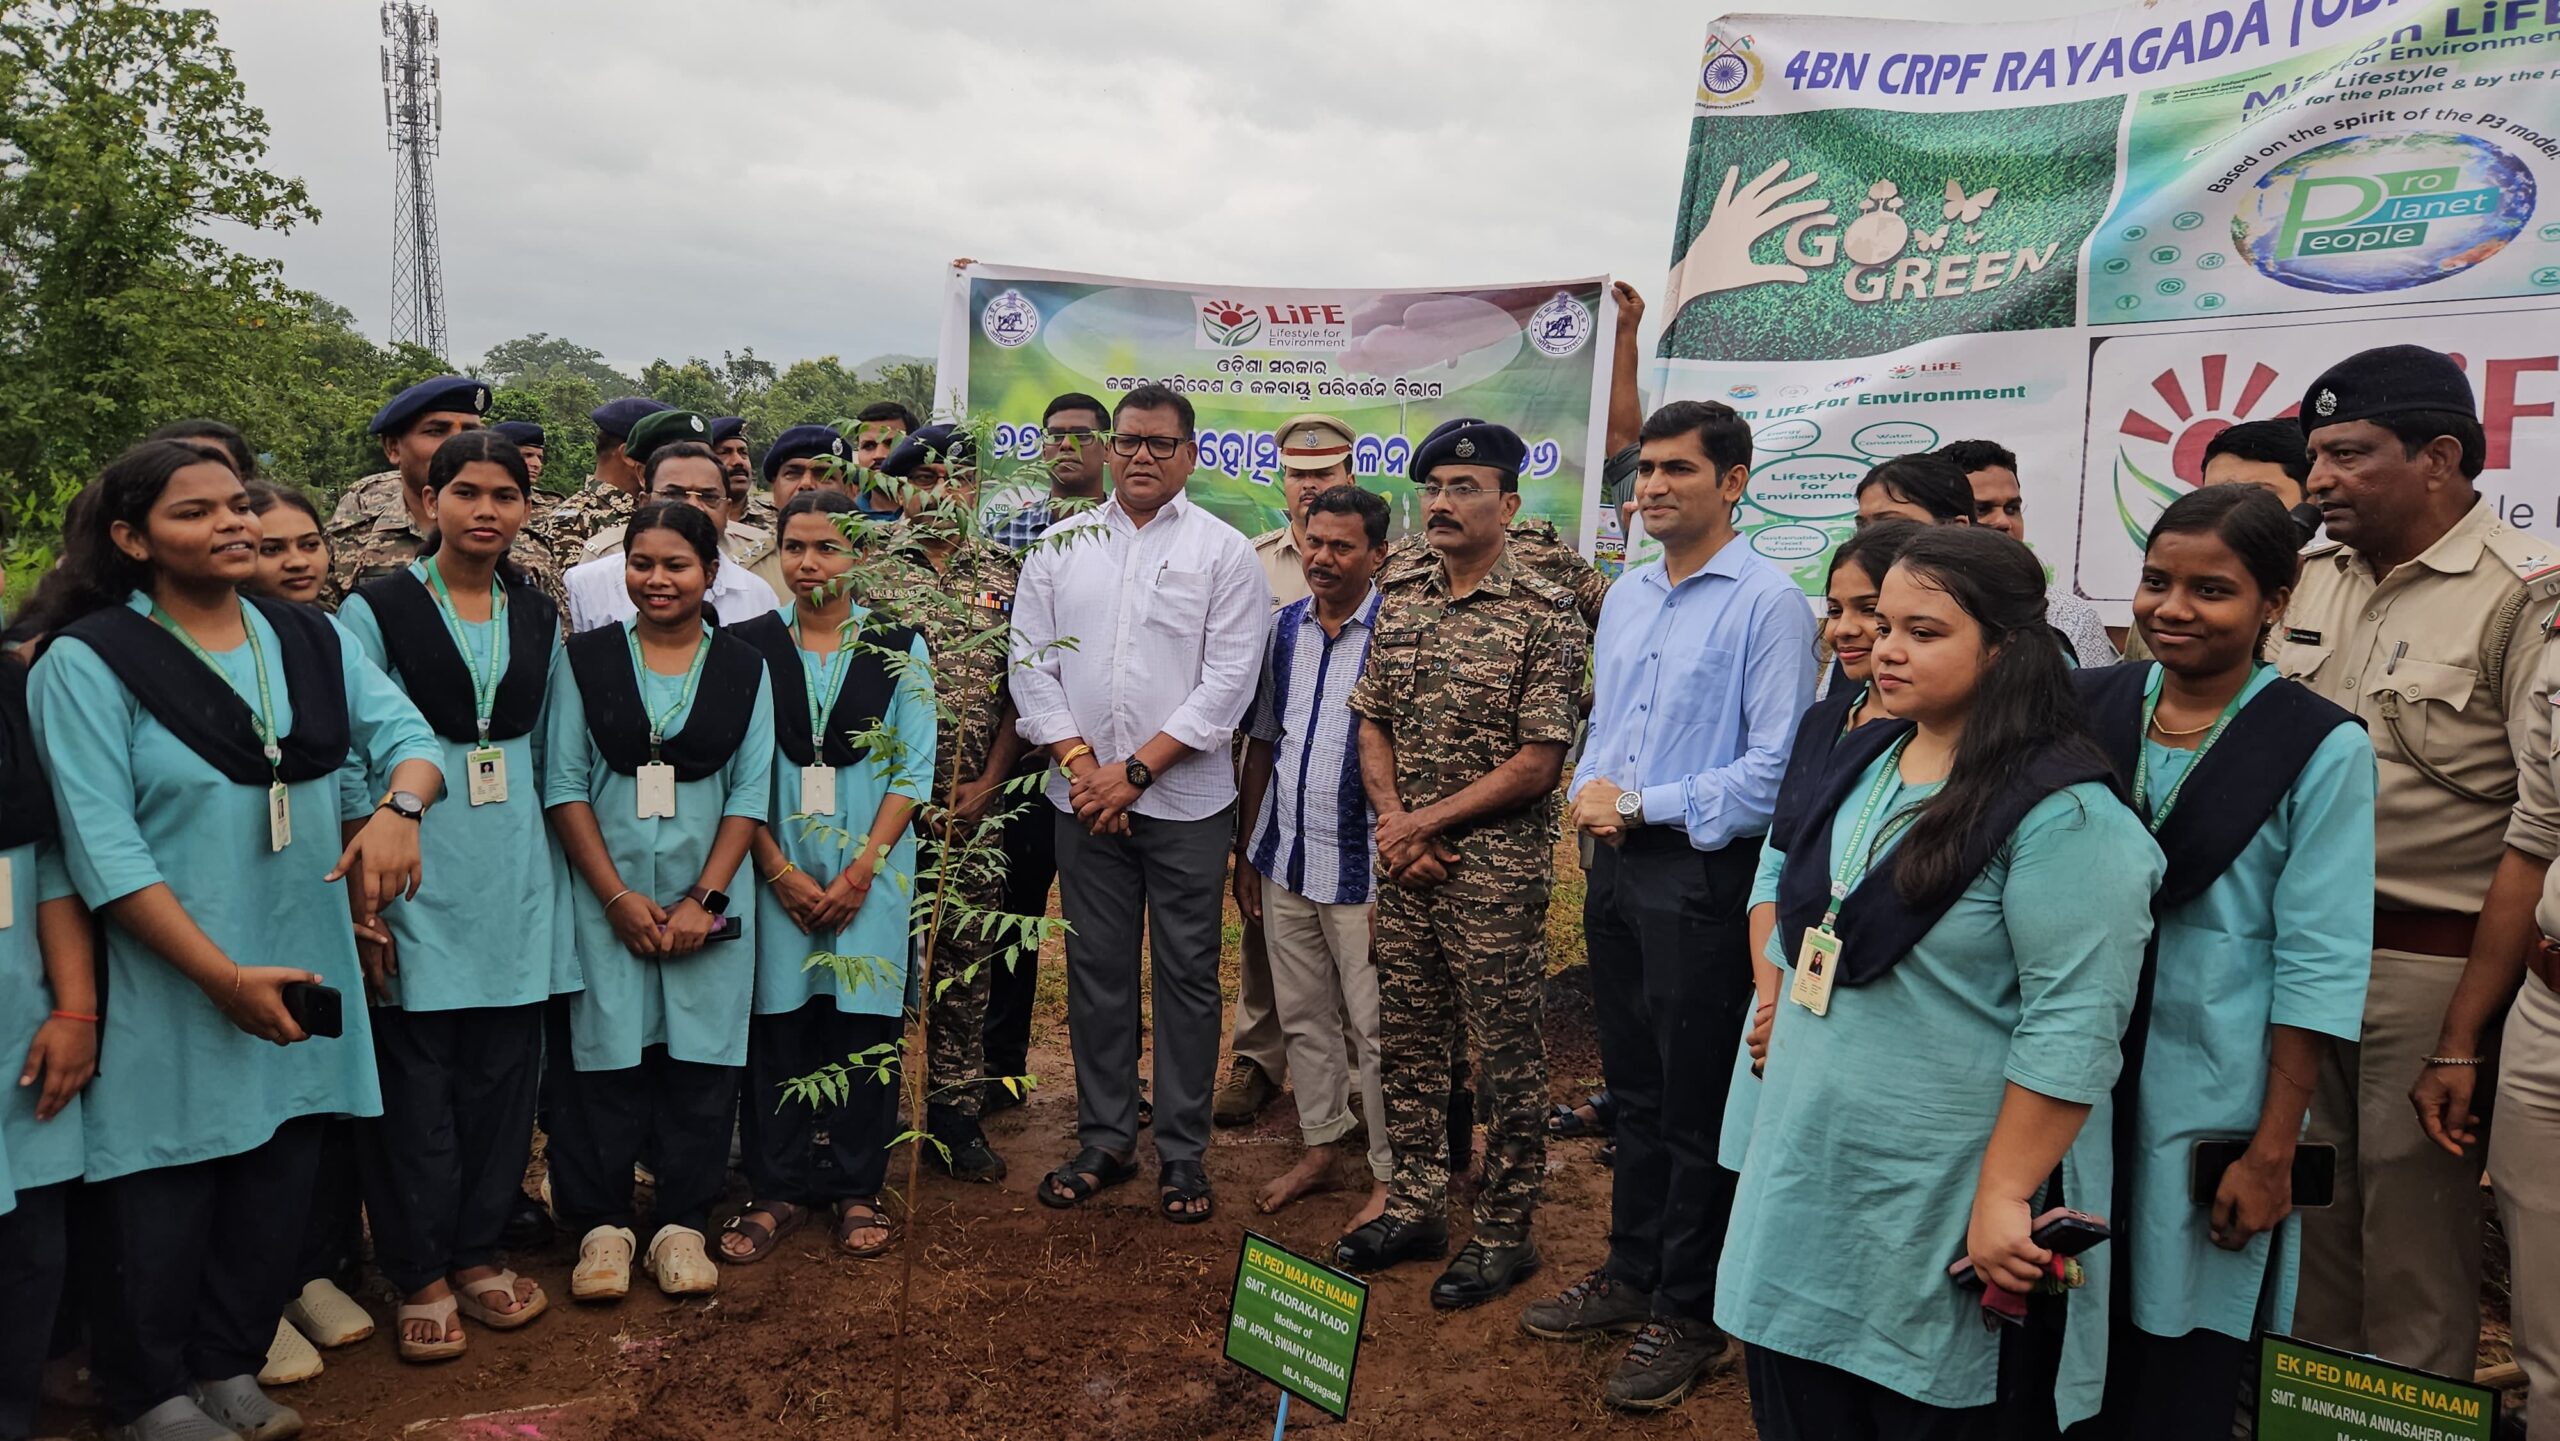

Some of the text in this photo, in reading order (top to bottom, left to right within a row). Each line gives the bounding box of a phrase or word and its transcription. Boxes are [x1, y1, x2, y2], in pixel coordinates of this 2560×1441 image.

[1784, 51, 1870, 91] 4BN
[1878, 53, 1988, 95] CRPF
[1992, 0, 2270, 92] RAYAGADA
[2305, 94, 2336, 106] for
[2340, 89, 2373, 101] the
[2378, 81, 2445, 99] planet
[2452, 78, 2466, 90] &
[2474, 75, 2503, 88] by
[2510, 69, 2545, 82] the
[2335, 65, 2448, 90] Lifestyle
[2207, 155, 2259, 195] Based
[2259, 140, 2288, 158] on
[2288, 124, 2328, 144] the
[2333, 109, 2396, 132] spirit
[2403, 107, 2430, 121] of
[2435, 109, 2473, 123] the
[2476, 113, 2508, 130] P3
[1784, 210, 1909, 267] GO
[1843, 242, 2060, 302] GREEN
[1265, 304, 1345, 325] LiFE
[1269, 328, 1341, 338] Lifestyle for
[1269, 337, 1345, 347] Environment
[1269, 360, 1327, 375] ସରକାର
[1921, 361, 1962, 372] LiFE
[1858, 385, 2026, 405] Environment
[1771, 472, 1858, 482] Lifestyle
[1800, 482, 1828, 490] for
[2204, 715, 2232, 751] STUDIES
[1845, 818, 1866, 860] INSTITUTE
[1868, 755, 1898, 806] PROFESSIONAL
[1247, 1247, 1358, 1310] EK PED MAA KE NAAM
[1244, 1275, 1350, 1335] SMT. KADRAKA KADO
[1273, 1312, 1313, 1339] Mother of
[1232, 1313, 1345, 1381] SRI APPAL SWAMY KADRAKA
[1282, 1364, 1342, 1404] MLA, Rayagada
[2276, 1352, 2479, 1419] EK PED MAA KE NAAM
[2270, 1388, 2297, 1409] SMT.
[2301, 1396, 2367, 1428] MANKARNA
